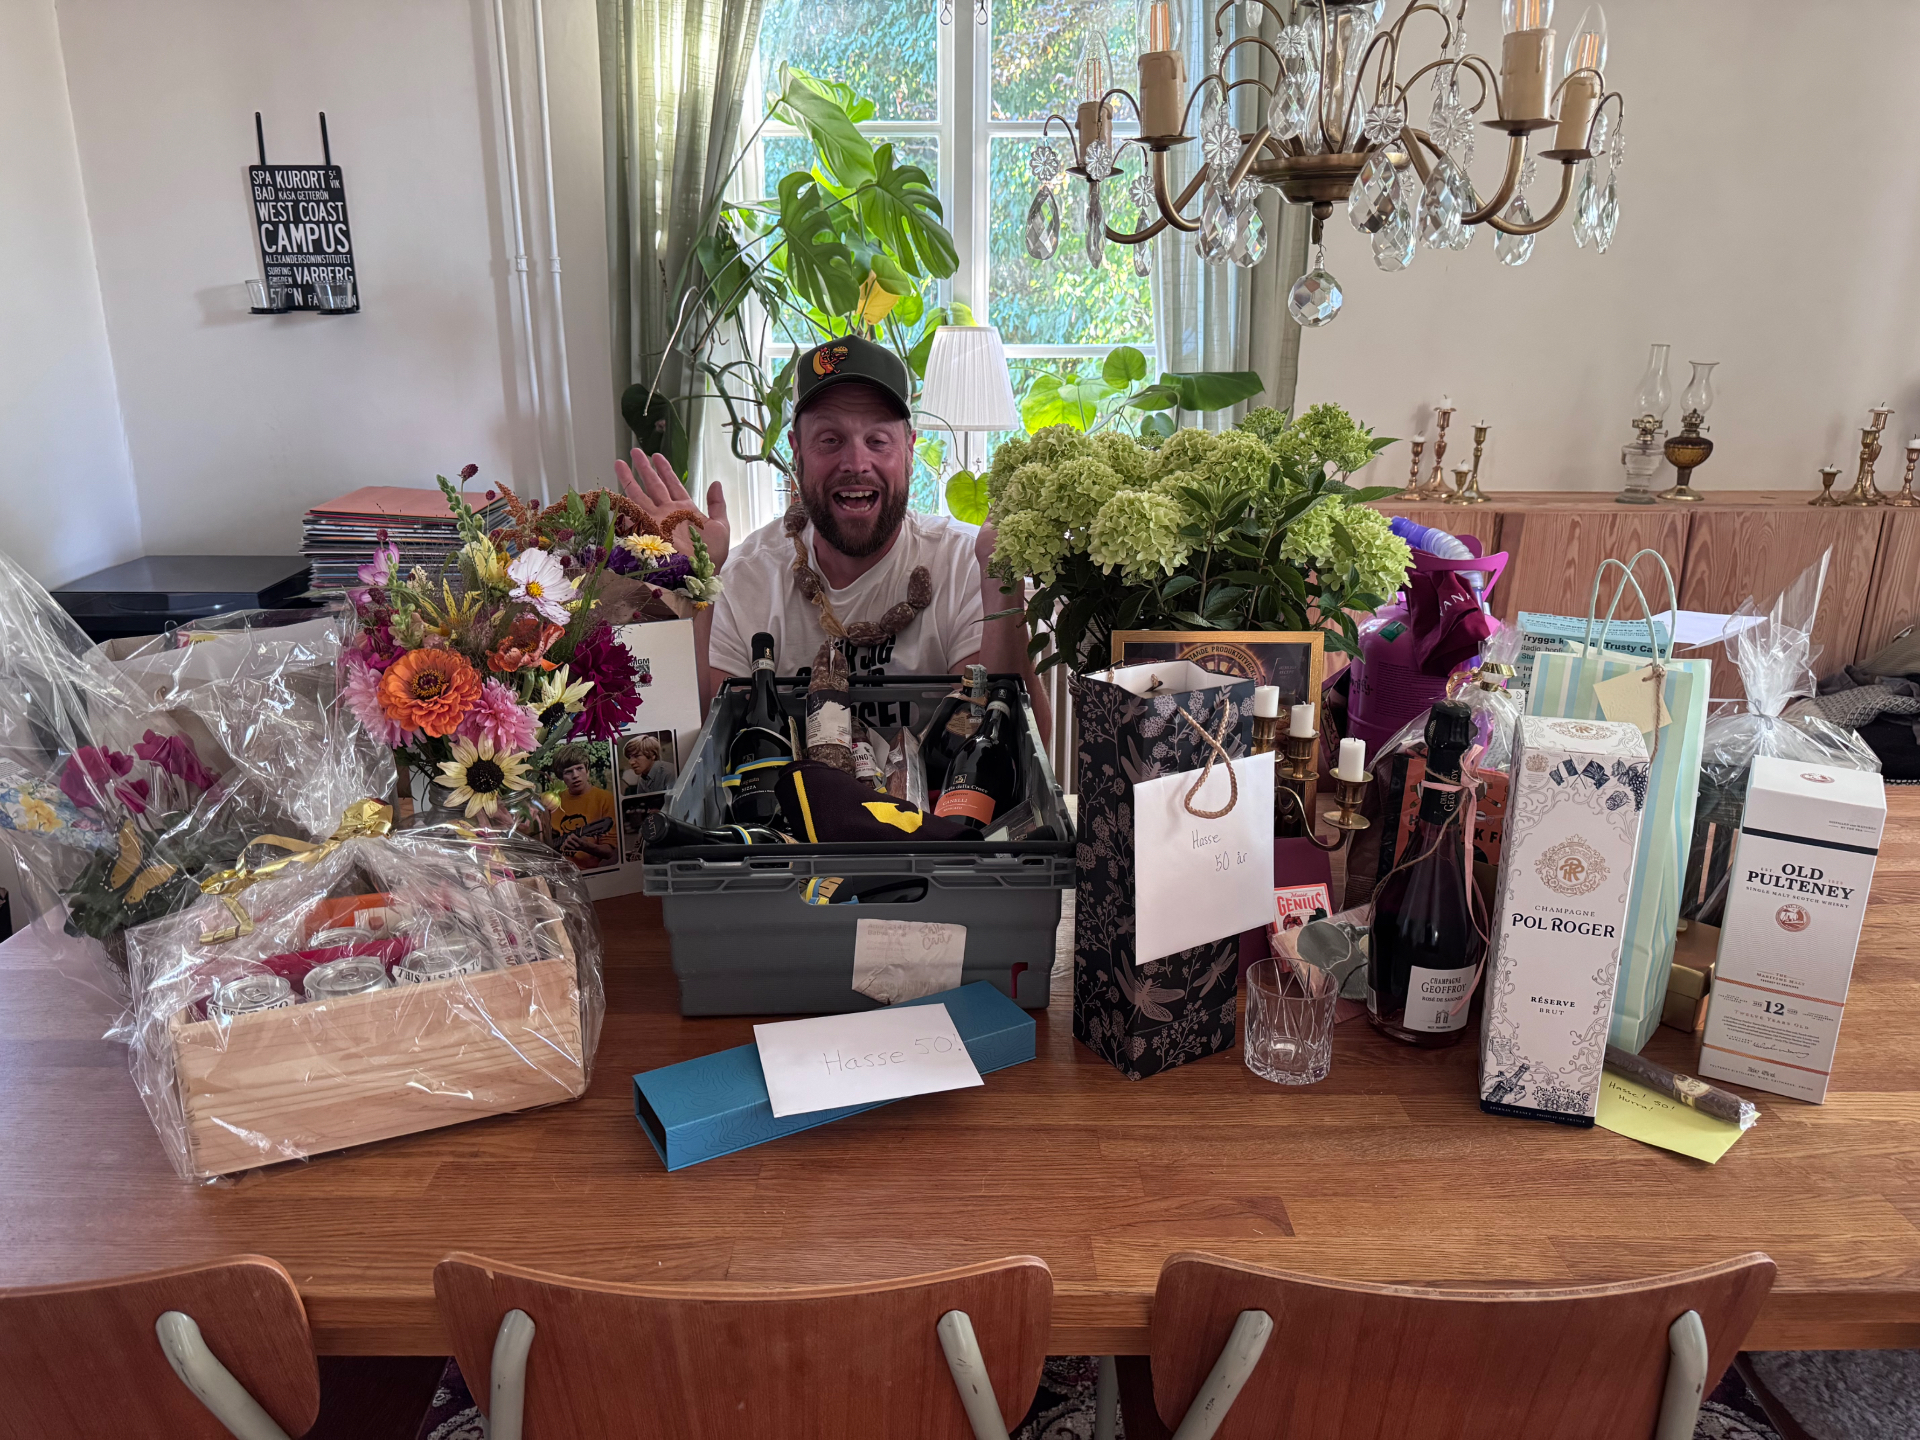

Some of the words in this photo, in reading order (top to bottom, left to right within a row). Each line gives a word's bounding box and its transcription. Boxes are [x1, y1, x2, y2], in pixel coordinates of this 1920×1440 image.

[252, 170, 273, 185] SPA
[275, 170, 325, 189] KURORT
[330, 180, 341, 188] VIK
[254, 186, 275, 200] BAD
[297, 190, 329, 200] GETTERÖN
[257, 201, 294, 222] WEST
[299, 201, 344, 222] COAST
[260, 223, 350, 253] CAMPUS
[265, 254, 351, 264] ALEXANDERSONINSTITUTET
[267, 266, 292, 275] SURFING
[293, 266, 354, 285] VARBERG
[1523, 634, 1556, 645] Trygga
[1604, 641, 1636, 653] Trusty
[1640, 645, 1666, 654] Cae
[1191, 829, 1221, 849] Hasse
[1215, 851, 1230, 872] 50
[1781, 863, 1824, 881] OLD
[1746, 870, 1855, 901] PULTENEY
[1277, 892, 1324, 916] GENIUS
[1746, 886, 1770, 894] SINGLE
[1772, 890, 1790, 898] MALT
[1792, 895, 1819, 904] SCOTCH
[1822, 900, 1849, 909] WHISKY
[1534, 905, 1596, 917] CHAMPAGNE
[1512, 913, 1547, 930] POL
[1551, 917, 1615, 938] ROGER
[398, 968, 420, 984] THIS
[1430, 977, 1461, 985] CHAMPAGNE
[1421, 981, 1467, 994] GEOFFROY
[1531, 996, 1576, 1008] RÉSERVE
[1763, 1000, 1785, 1016] 12
[1539, 1007, 1564, 1016] BRUT
[1734, 1010, 1764, 1020] TWELVE
[1767, 1016, 1791, 1026] YEARS
[1794, 1022, 1809, 1030] OLD
[823, 1049, 906, 1075] Hasse
[1536, 1086, 1549, 1095] POL
[1551, 1086, 1576, 1094] ROGER
